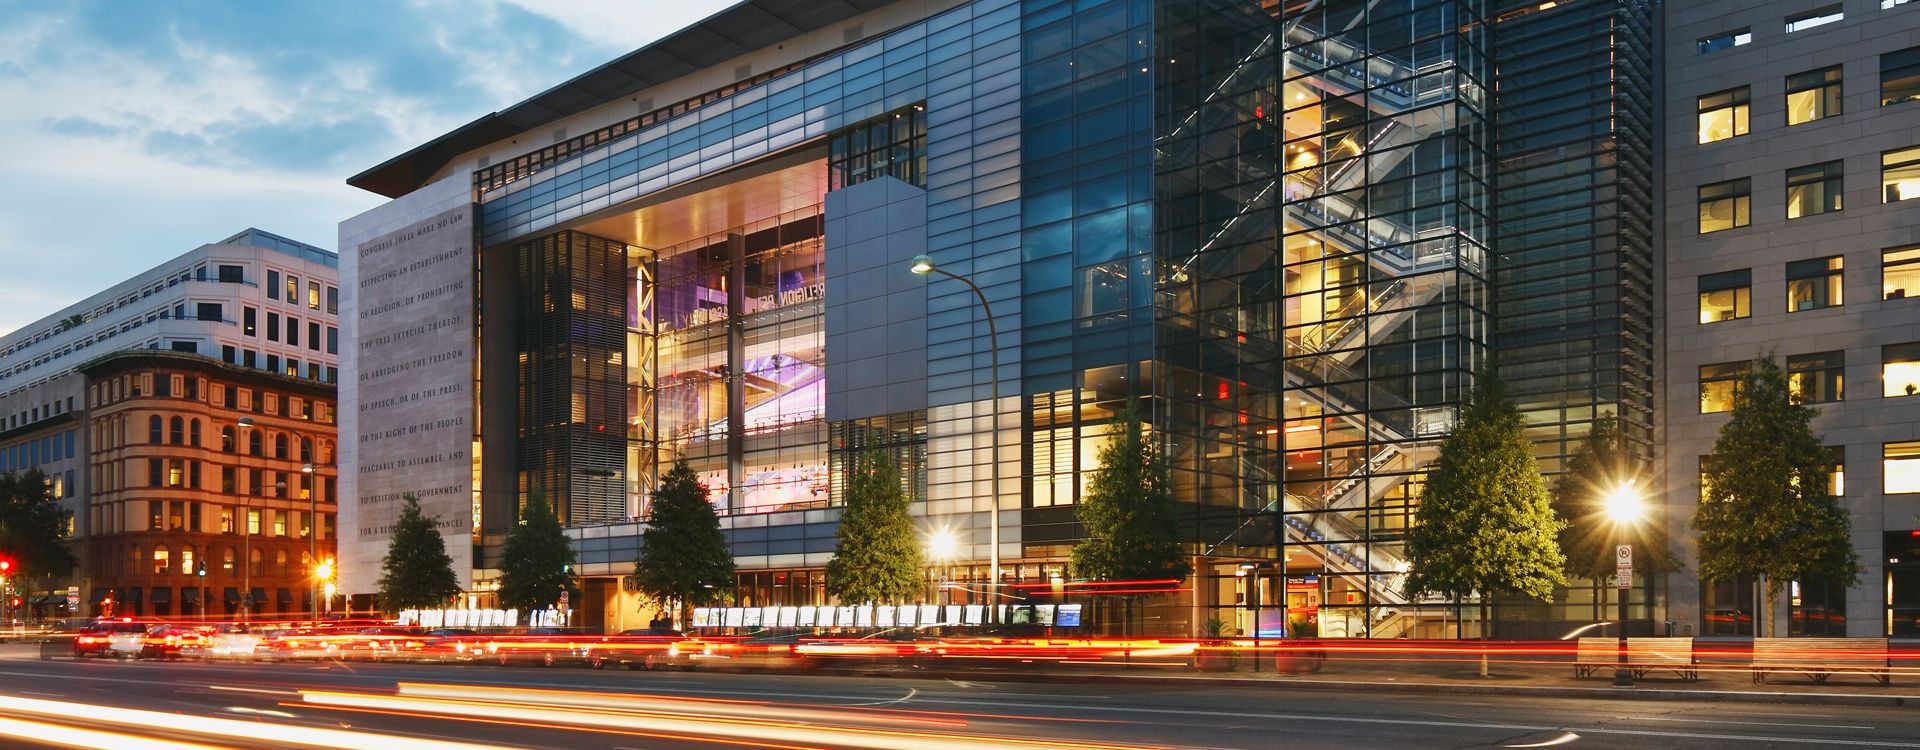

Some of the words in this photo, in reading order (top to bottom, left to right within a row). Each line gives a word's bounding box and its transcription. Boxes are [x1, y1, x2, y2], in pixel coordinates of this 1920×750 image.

[360, 239, 393, 258] CONGRESS
[395, 232, 414, 246] SHALL
[417, 223, 435, 236] MAKE
[438, 219, 448, 229] NO
[450, 213, 464, 225] LAW
[360, 270, 397, 288] RESPECTING
[399, 266, 408, 275] AN
[410, 247, 463, 272] ESTABLISHMENT
[360, 311, 368, 319] OF
[405, 296, 414, 305] OR
[417, 281, 464, 302] PROHIBITING
[360, 342, 372, 350] THE
[375, 336, 390, 345] FREE
[393, 326, 424, 341] EXERCISE
[360, 373, 368, 381] OR
[371, 362, 410, 378] ABRIDGING
[413, 358, 426, 368] THE
[429, 349, 463, 364] FREEDOM
[360, 404, 368, 412] OF
[400, 395, 408, 404] OR
[411, 392, 419, 400] OF
[422, 389, 436, 398] THE
[370, 431, 382, 440] THE
[385, 427, 406, 438] RIGHT
[409, 426, 417, 434] OF
[420, 422, 433, 431] THE
[437, 417, 463, 429] PEOPLE
[360, 462, 394, 474] PEACEABLY
[397, 460, 405, 468] TO
[448, 451, 464, 460] AND
[360, 496, 368, 504] TO
[370, 492, 400, 503] PETITION
[417, 485, 463, 498] GOVERNMENT
[360, 528, 371, 536] FOR
